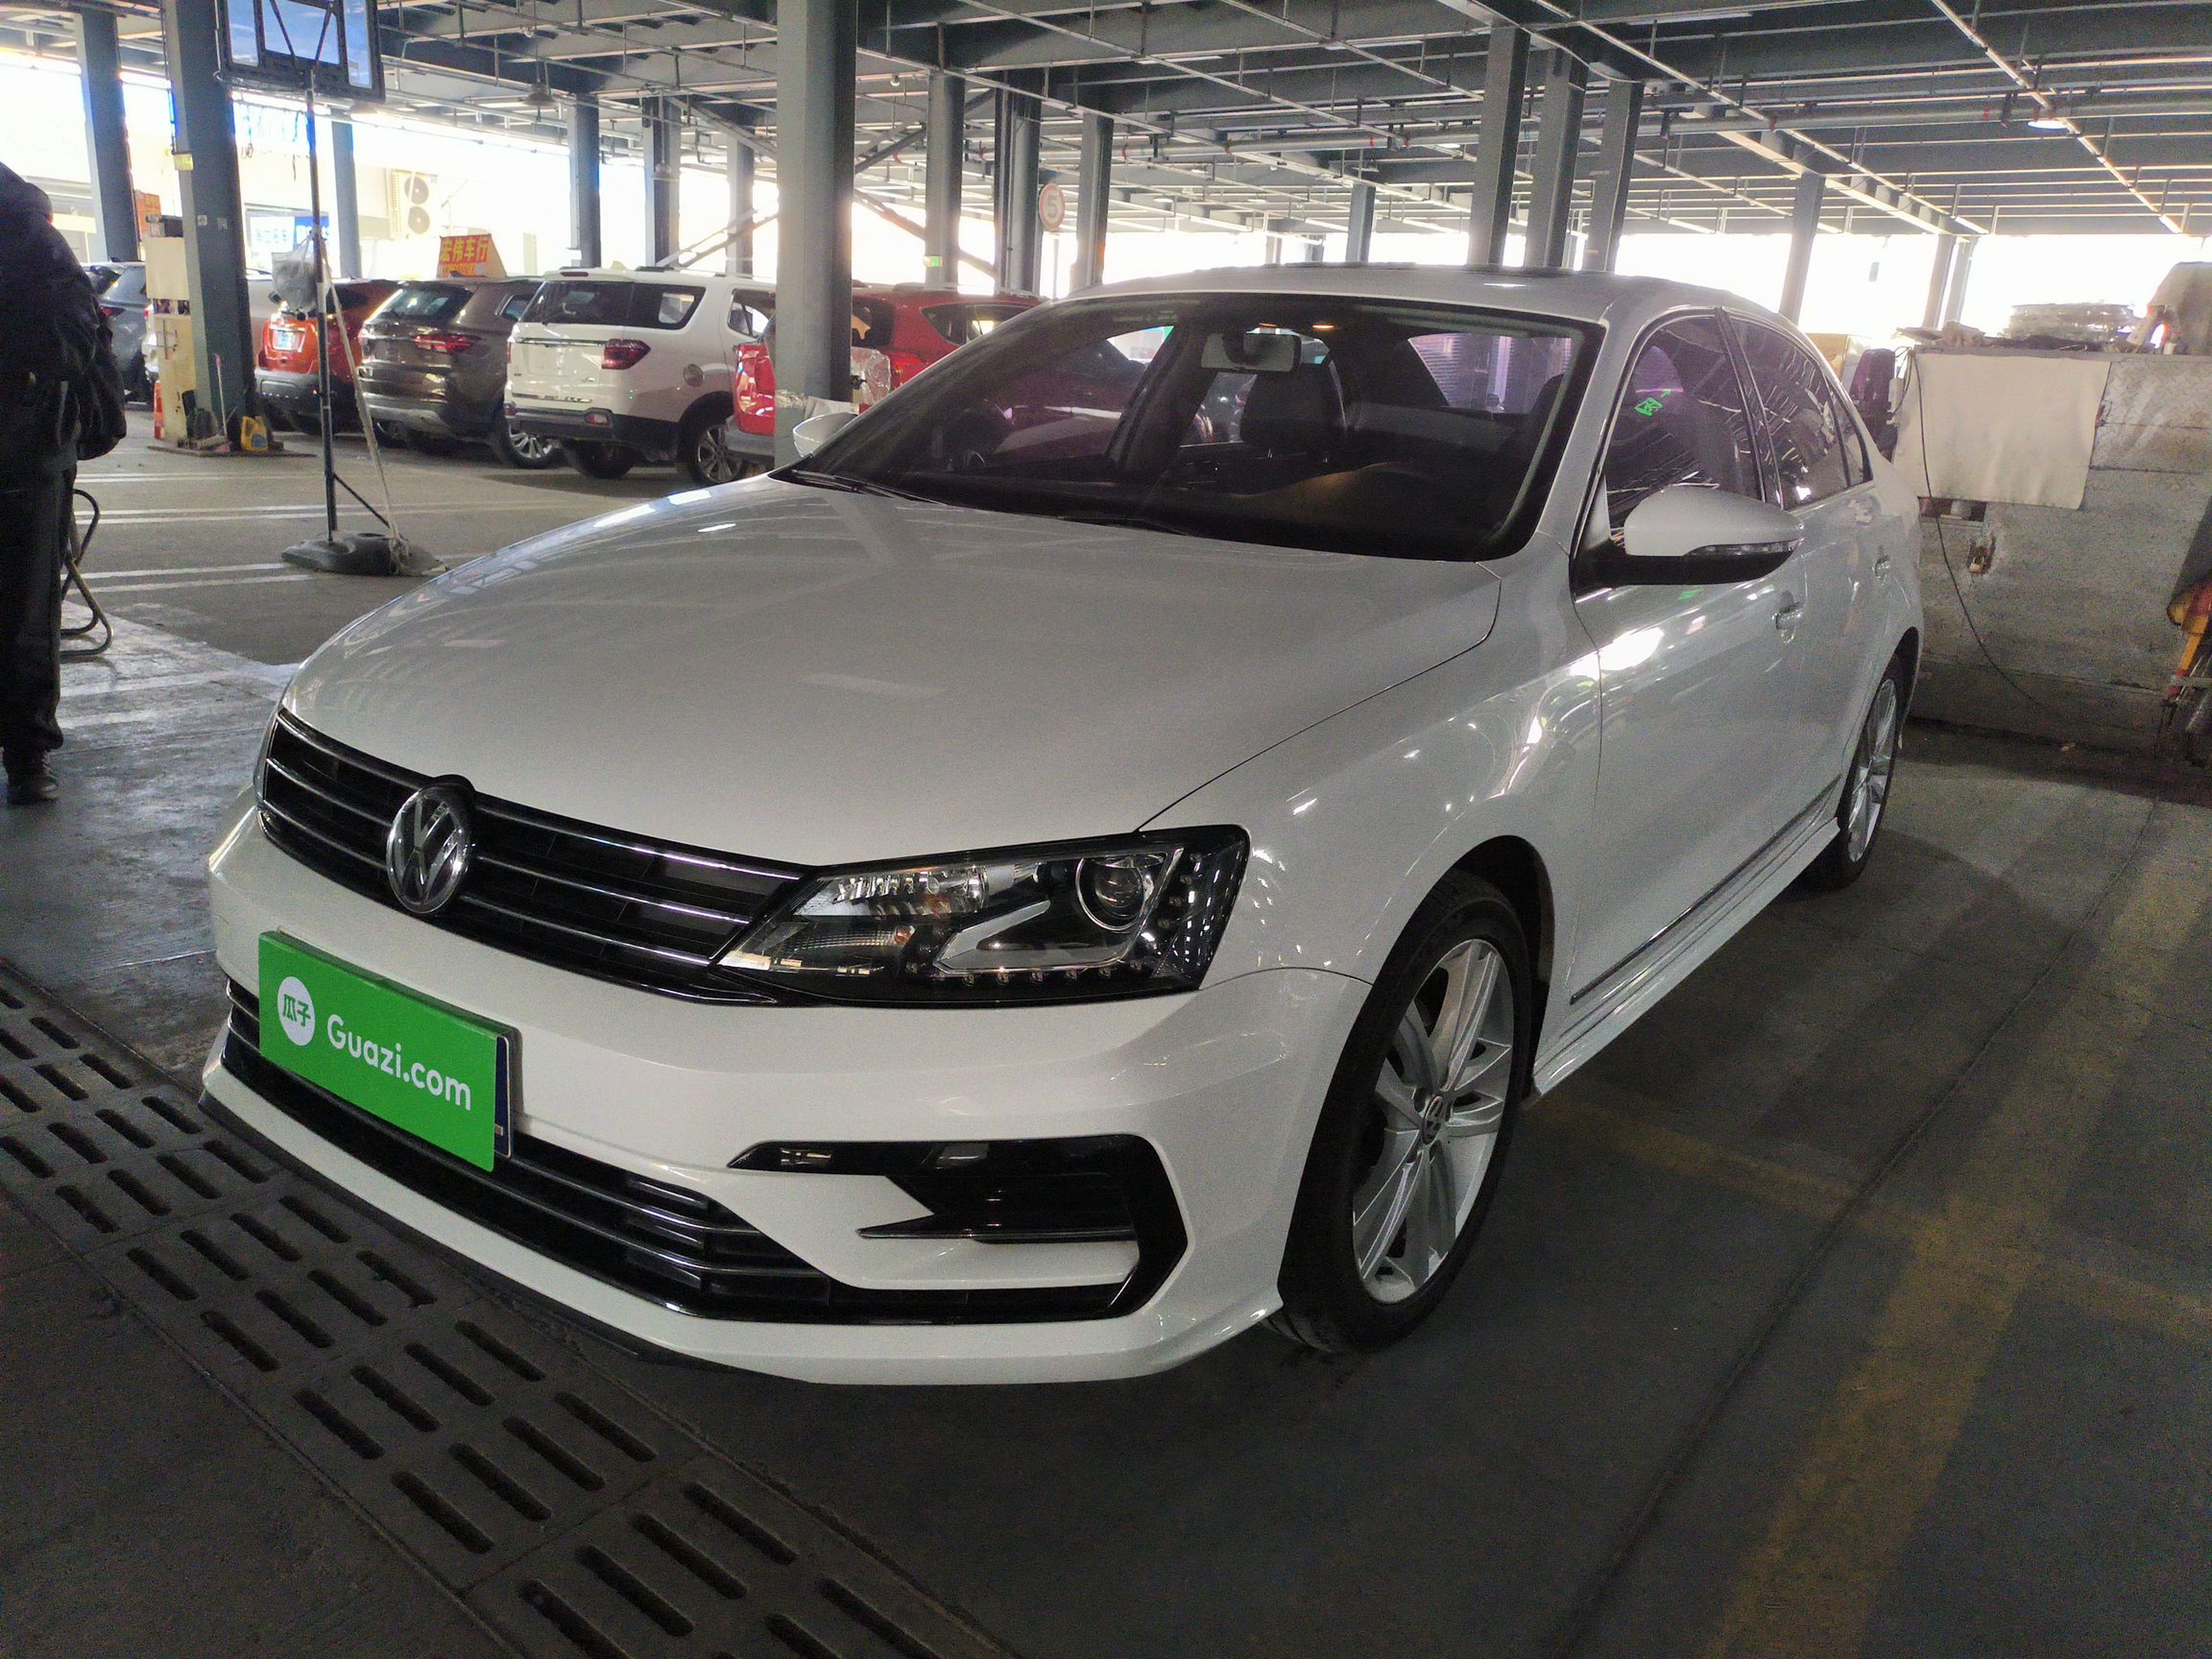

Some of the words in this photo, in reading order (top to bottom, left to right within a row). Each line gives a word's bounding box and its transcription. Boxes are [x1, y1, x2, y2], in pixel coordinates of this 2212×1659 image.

[1048, 194, 1059, 218] 5
[283, 994, 312, 1027] 瓜子
[327, 1014, 471, 1111] Guazi.com
